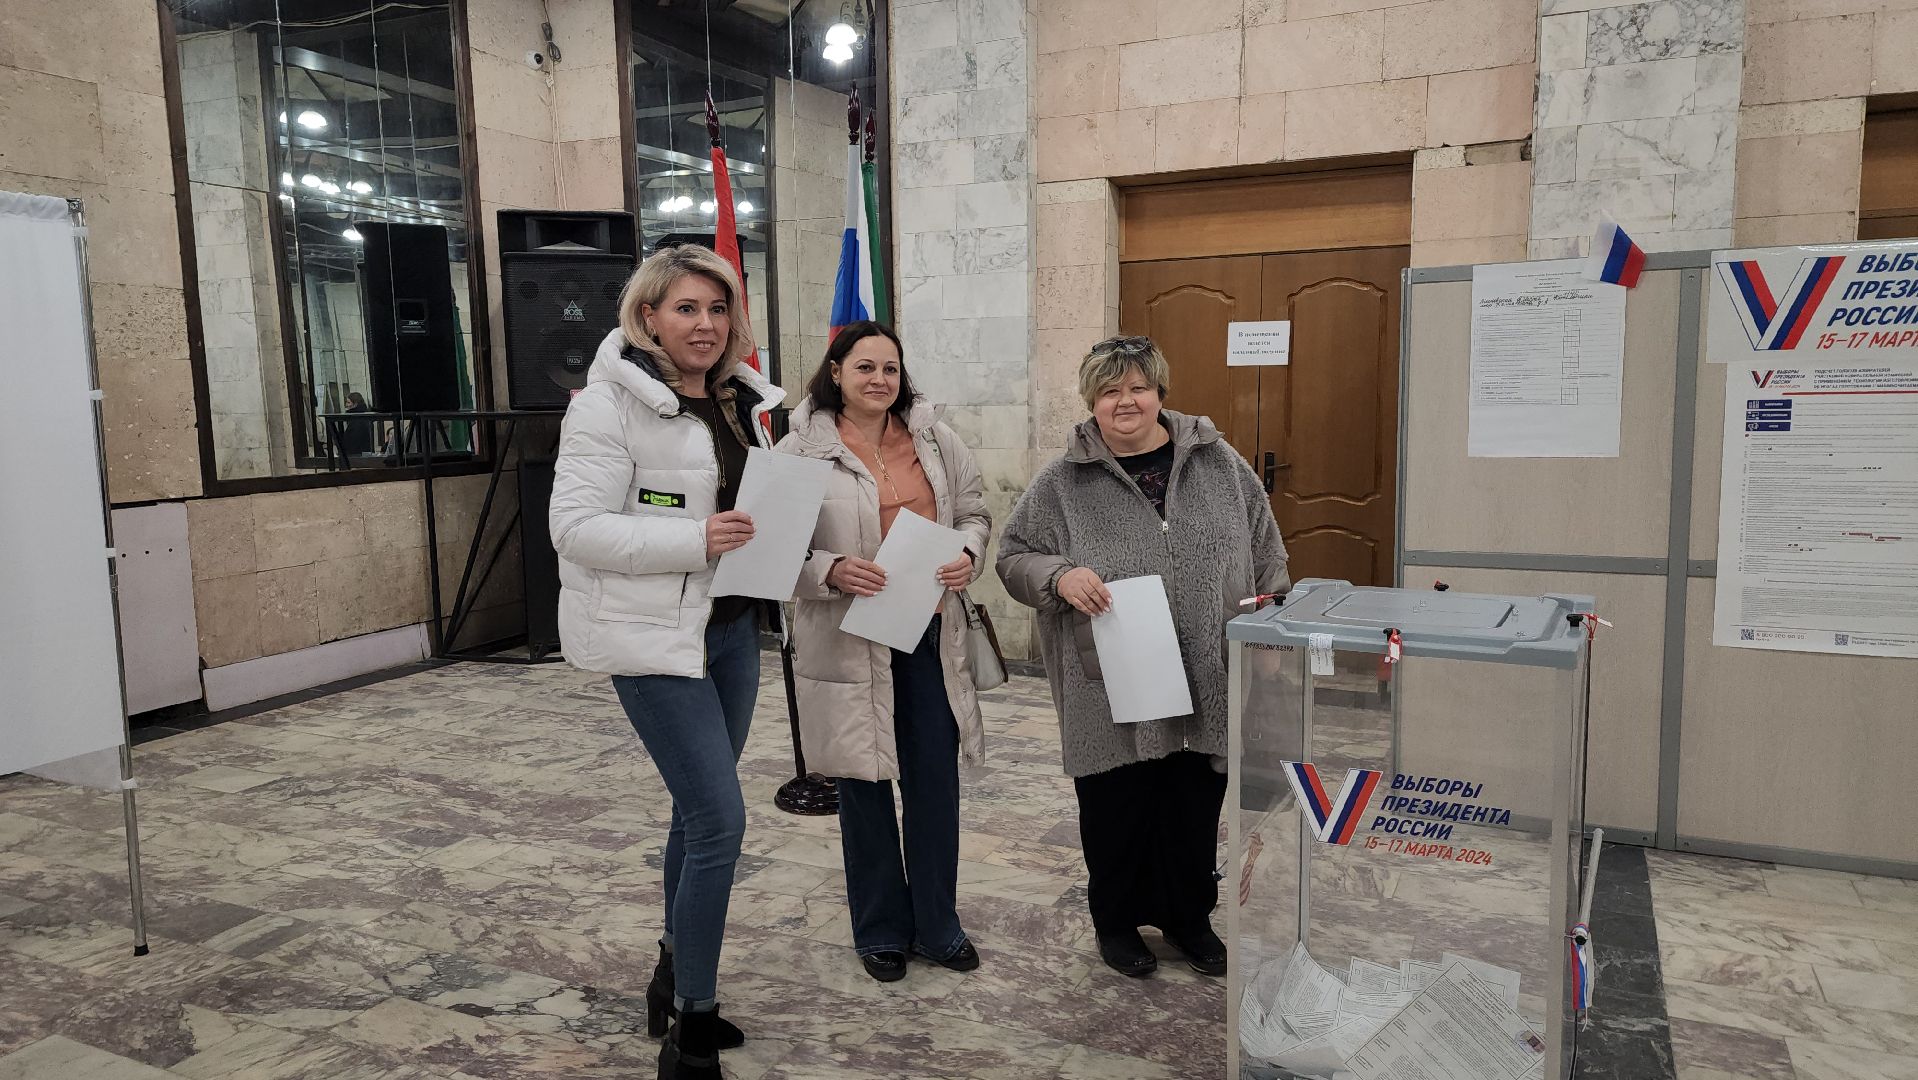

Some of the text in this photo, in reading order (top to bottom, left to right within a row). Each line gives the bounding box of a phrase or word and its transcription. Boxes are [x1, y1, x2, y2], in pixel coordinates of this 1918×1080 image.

[1856, 252, 1918, 274] ВЫБ
[563, 308, 583, 316] ROSS
[1391, 773, 1484, 799] ВЫБОРЫ
[1380, 795, 1511, 826] ПРЕЗИДЕНТА
[1371, 816, 1454, 840] РОССИИ
[1404, 841, 1452, 859] МАРТА
[1455, 848, 1493, 866] 2024
